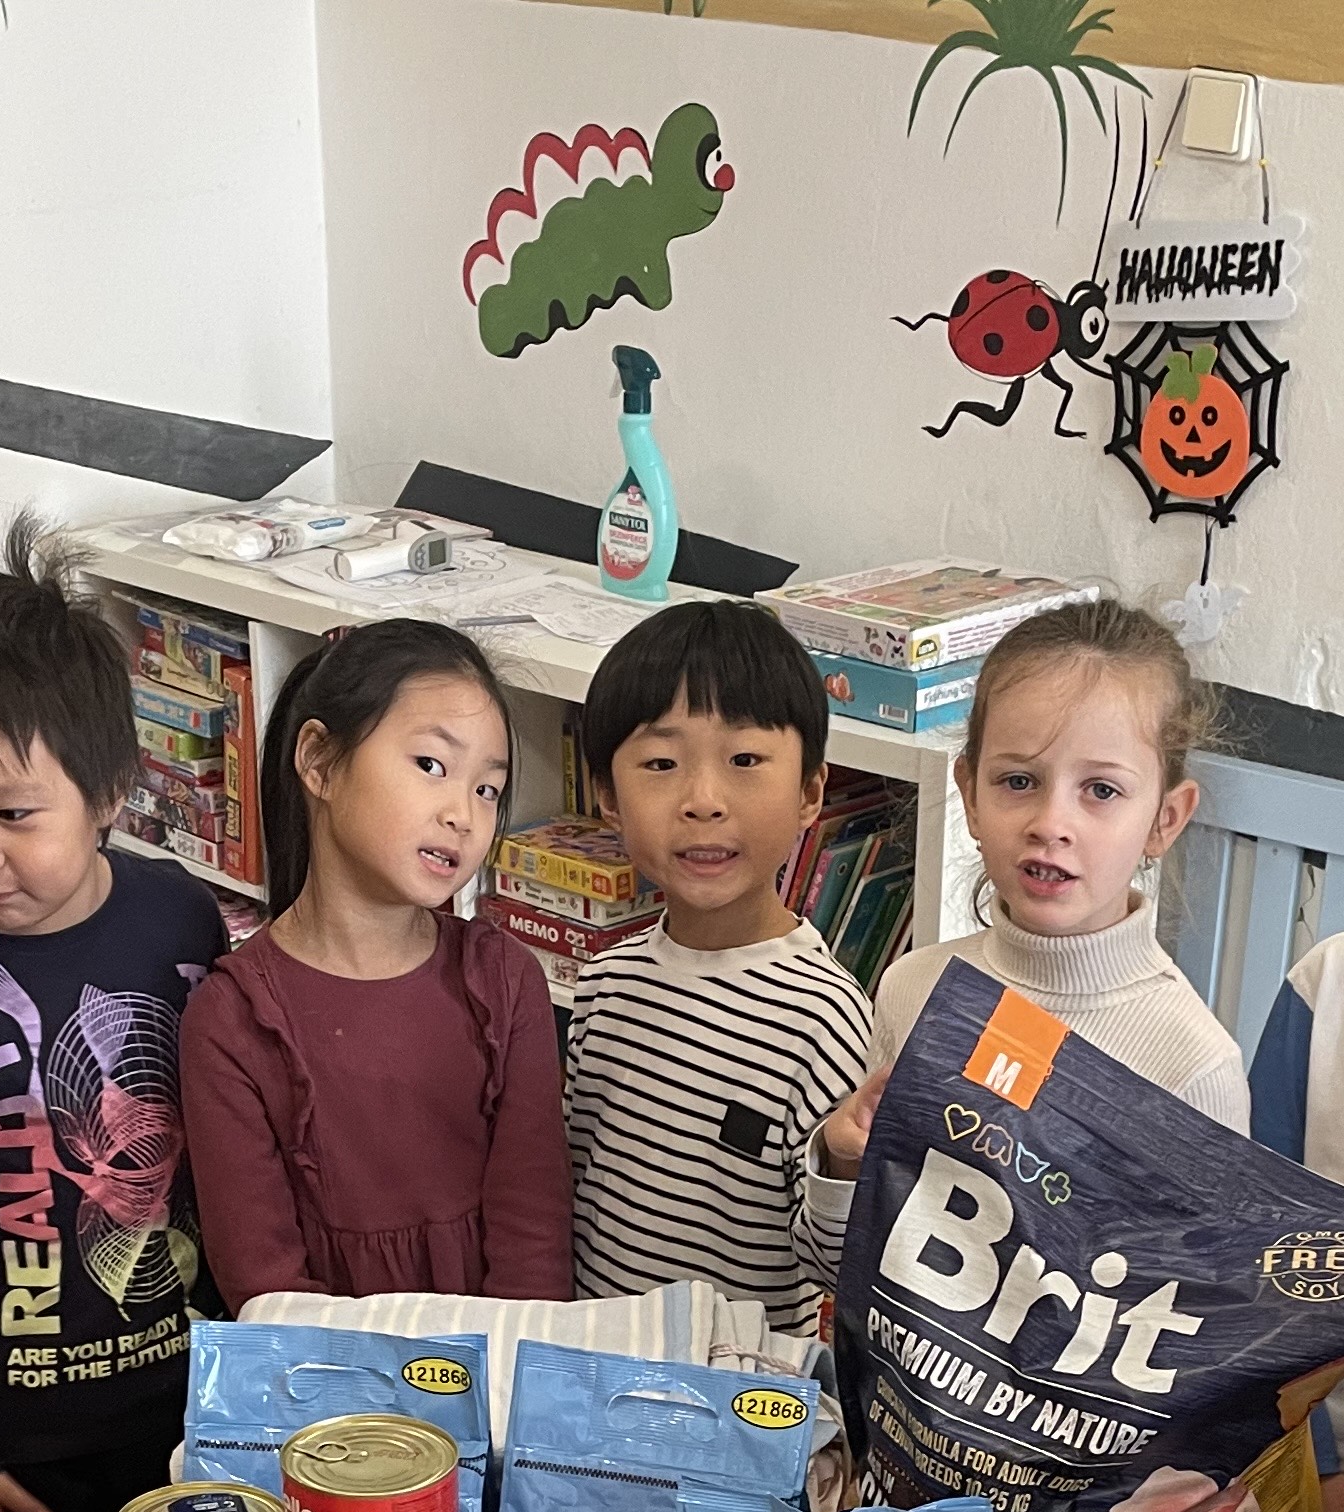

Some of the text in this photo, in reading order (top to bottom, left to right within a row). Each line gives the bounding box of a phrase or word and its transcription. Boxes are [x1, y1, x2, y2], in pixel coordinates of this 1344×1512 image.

[1116, 239, 1285, 304] HALLOWEEN
[509, 914, 559, 943] MEMO
[985, 1052, 1023, 1095] M
[878, 1147, 1204, 1394] Brit
[1291, 1281, 1339, 1298] SOY
[7, 1313, 178, 1366] ARE YOU READY
[7, 1331, 191, 1389] FOR THE FUTURE
[405, 1363, 469, 1388] 121868
[868, 1306, 1158, 1456] PREMIUM BY NATURE
[736, 1396, 805, 1420] 121868
[869, 1399, 884, 1422] OF
[914, 1450, 963, 1491] BREEDS
[963, 1448, 996, 1477] FOR
[997, 1461, 1050, 1487] ADULT
[1048, 1475, 1094, 1492] DOGS
